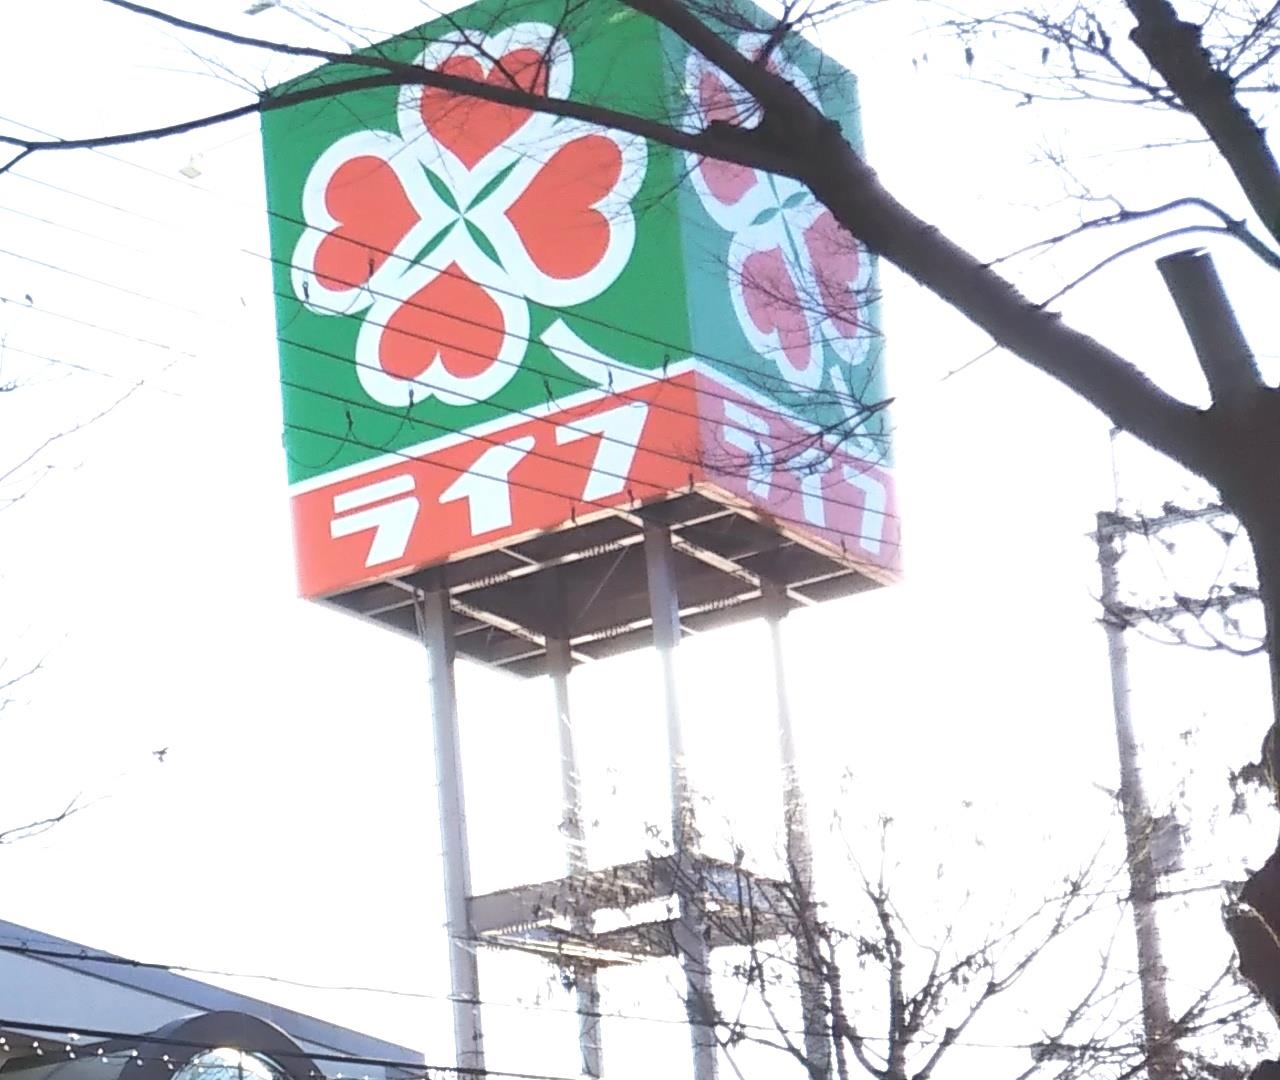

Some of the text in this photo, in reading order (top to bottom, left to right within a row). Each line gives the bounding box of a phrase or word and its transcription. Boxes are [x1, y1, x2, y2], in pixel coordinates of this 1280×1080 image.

[330, 402, 650, 568] ライフ
[722, 398, 886, 557] ライフ
